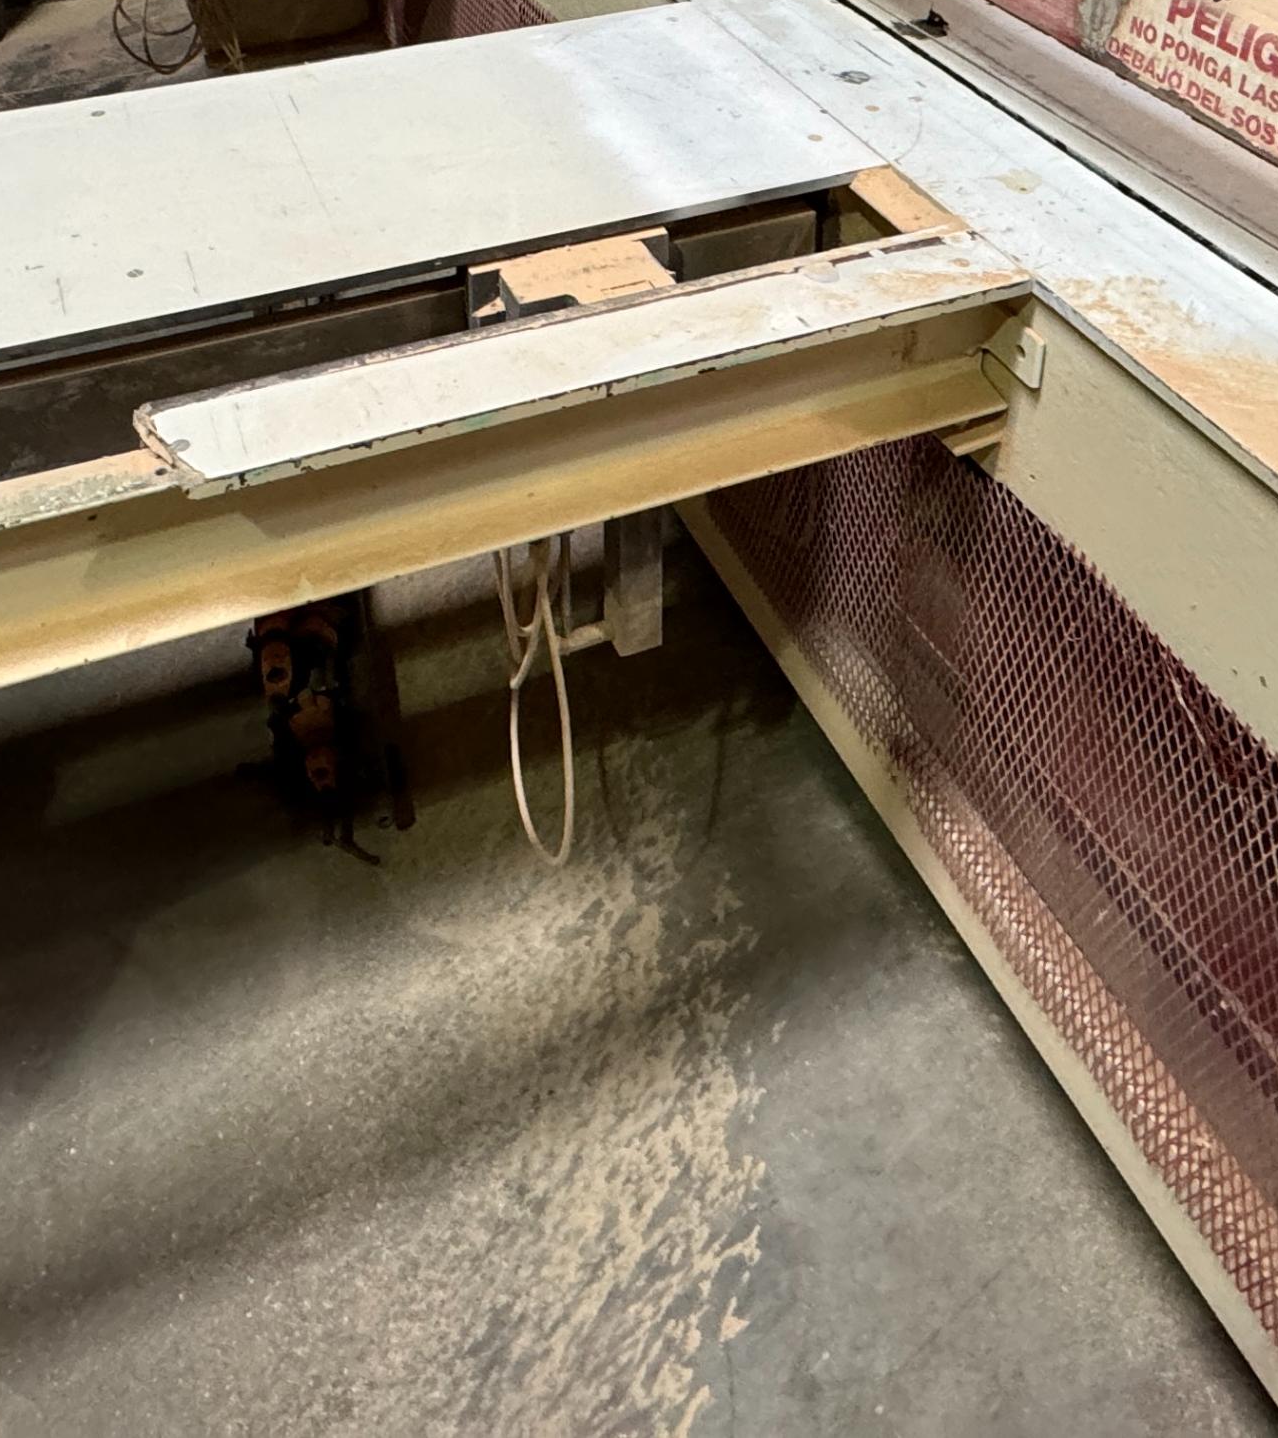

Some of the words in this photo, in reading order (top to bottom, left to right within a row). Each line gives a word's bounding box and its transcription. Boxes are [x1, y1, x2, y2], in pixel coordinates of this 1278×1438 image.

[1107, 36, 1183, 92] DEBAJO
[1185, 80, 1227, 119] DEL
[1129, 16, 1158, 44] NO
[1160, 32, 1233, 88] PONGA
